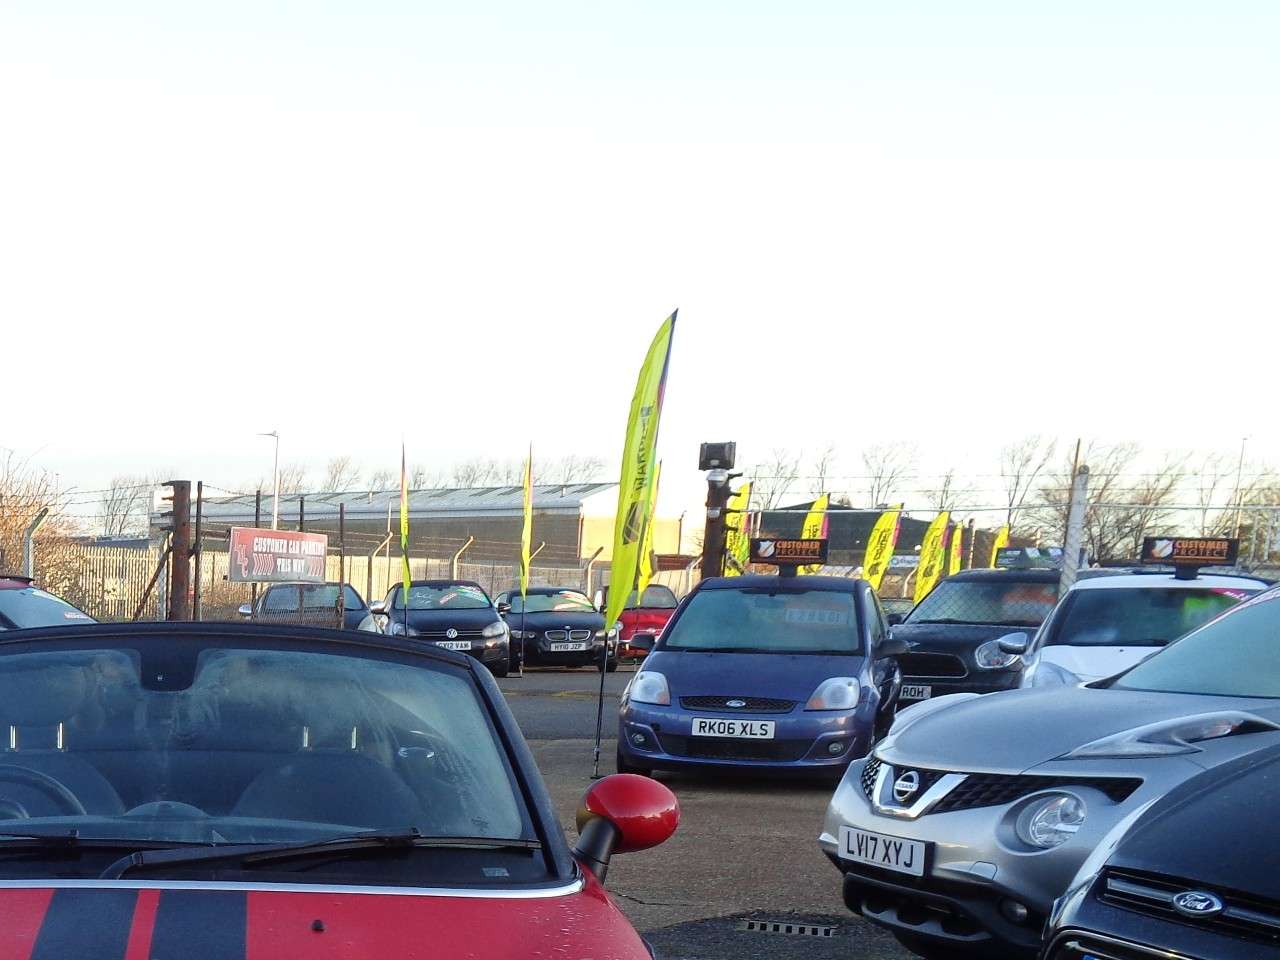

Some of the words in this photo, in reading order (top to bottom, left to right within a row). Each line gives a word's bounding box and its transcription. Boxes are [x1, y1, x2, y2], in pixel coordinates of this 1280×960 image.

[254, 537, 288, 554] CUSTOMER
[776, 541, 820, 549] CUSTOMER
[1175, 540, 1228, 549] CUSTOMER
[776, 548, 820, 557] PROTECT
[1174, 548, 1228, 557] PROTECT
[277, 557, 292, 573] THIS
[293, 559, 305, 573] WAY
[902, 686, 924, 698] ROH
[698, 720, 736, 736] RK06
[739, 722, 769, 737] XLS
[846, 830, 878, 860] LV17
[882, 838, 914, 868] XYJ
[1179, 892, 1210, 911] Ford
